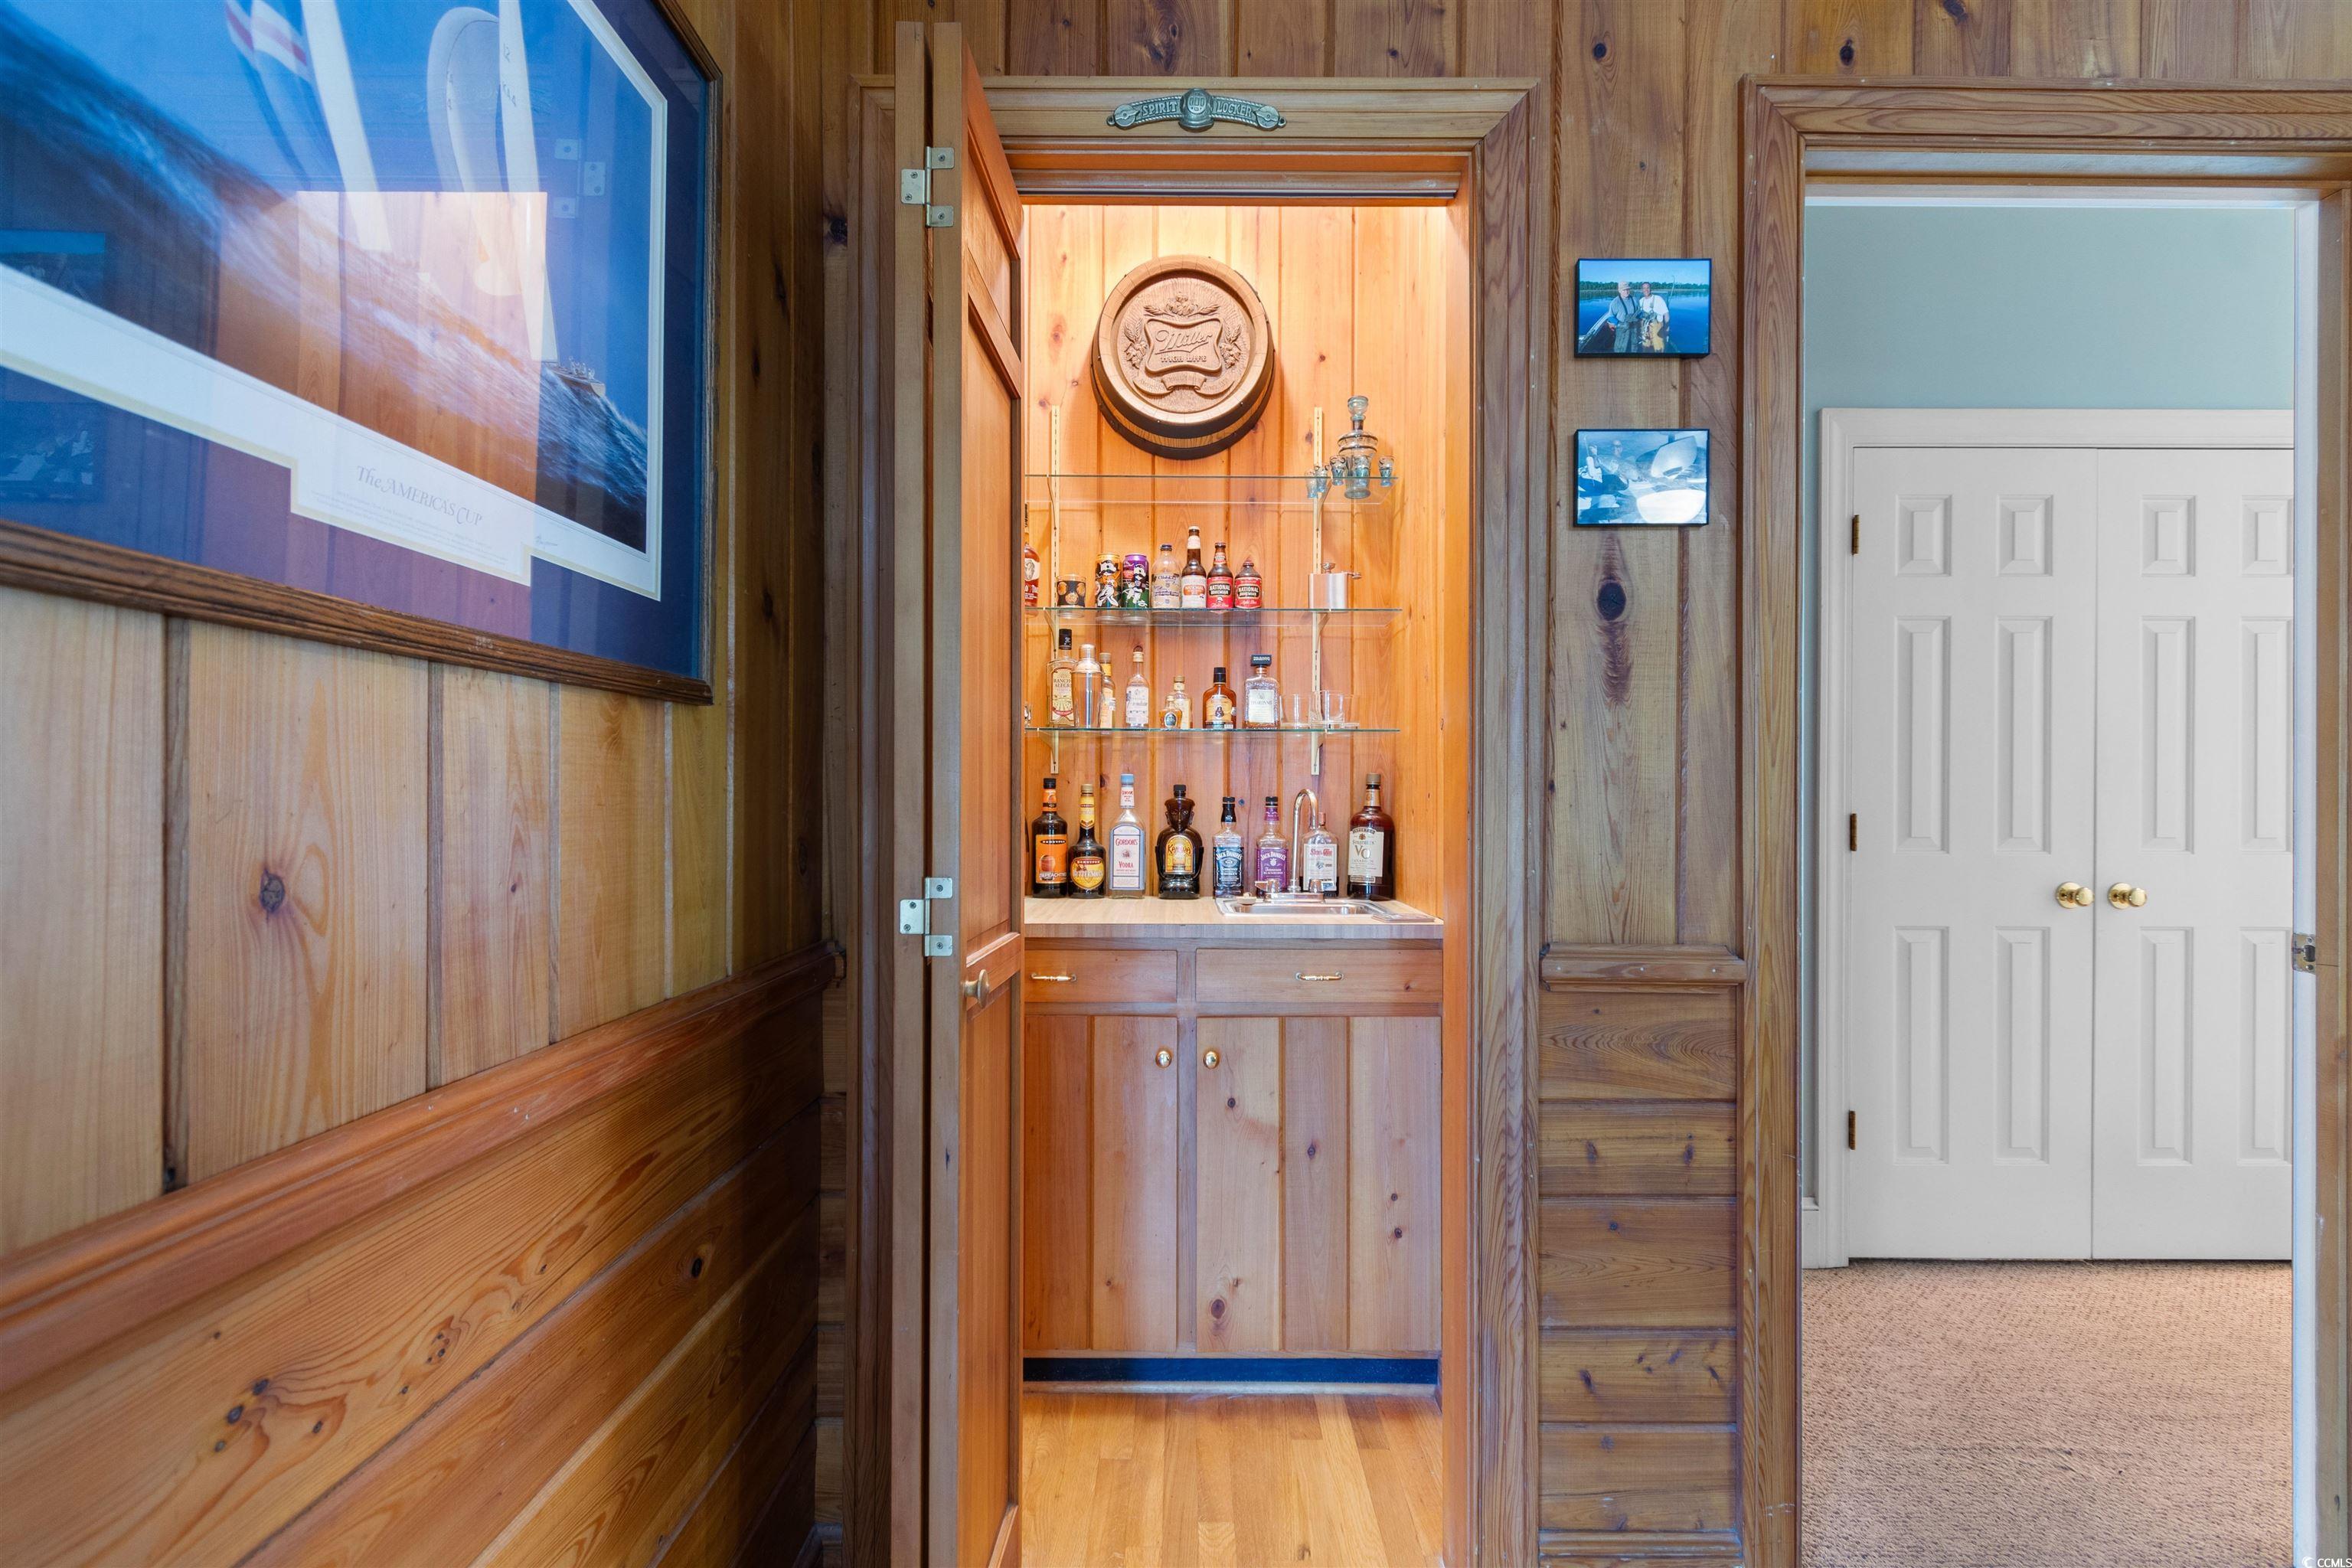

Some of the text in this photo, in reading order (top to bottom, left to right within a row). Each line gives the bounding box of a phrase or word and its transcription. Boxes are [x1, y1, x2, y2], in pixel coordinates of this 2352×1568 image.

[1142, 100, 1253, 117] SPIRIT LOCKER
[1155, 329, 1214, 354] Miller
[357, 465, 381, 488] The
[456, 507, 483, 525] CUP
[1216, 850, 1242, 861] JACK DANIEL'S
[1270, 851, 1287, 861] DANIEL'S
